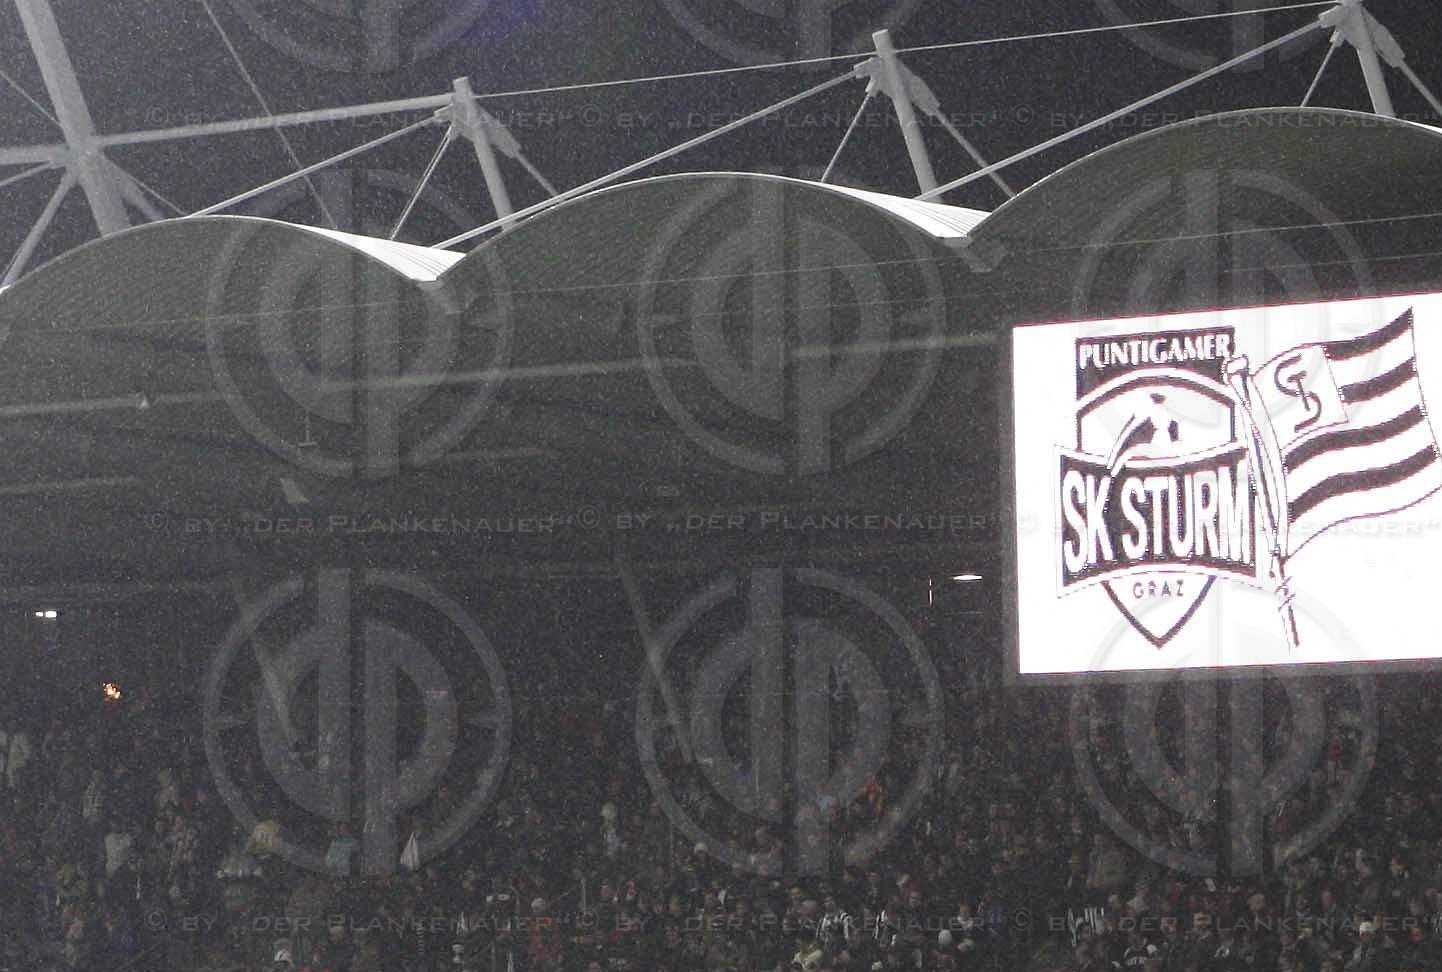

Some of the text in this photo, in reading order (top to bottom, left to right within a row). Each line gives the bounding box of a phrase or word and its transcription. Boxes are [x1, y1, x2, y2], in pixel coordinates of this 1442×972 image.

[1080, 334, 1231, 369] PUNTIGAMER
[1063, 457, 1256, 573] SK STURM
[1133, 580, 1184, 599] GRAZ
